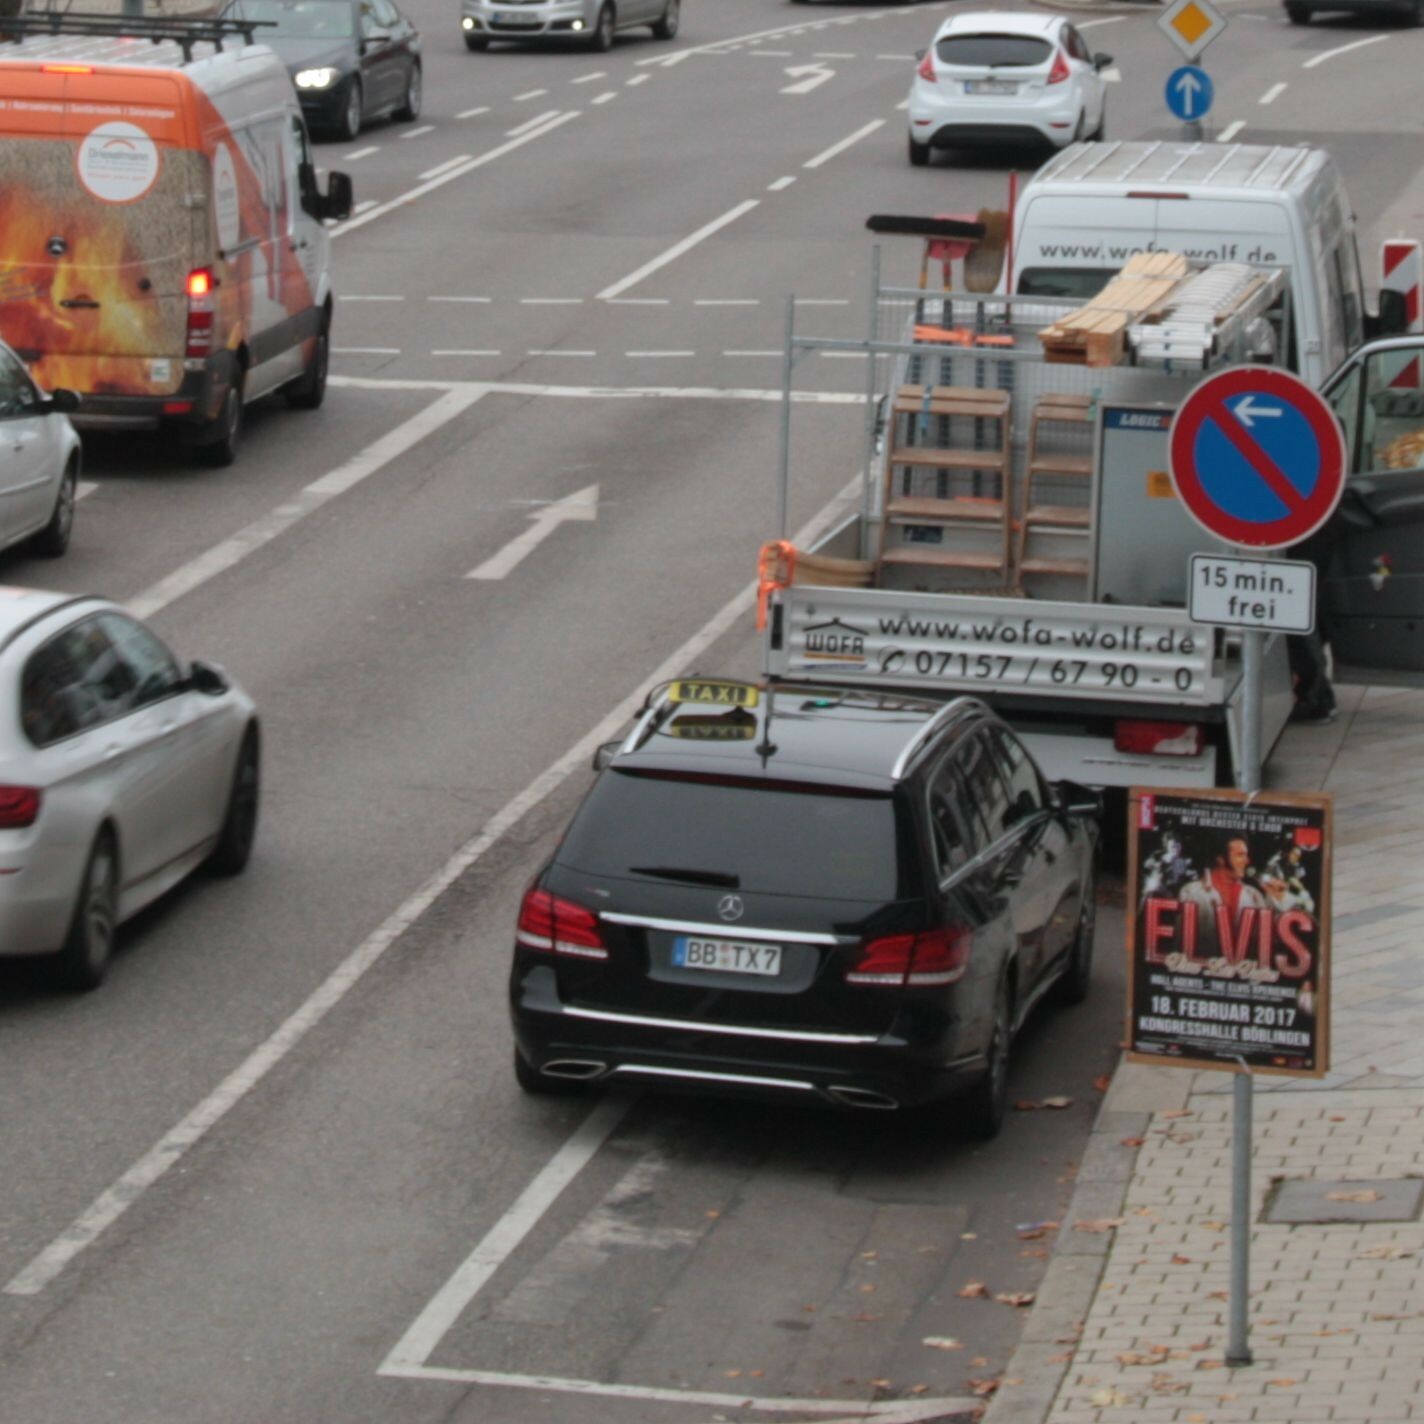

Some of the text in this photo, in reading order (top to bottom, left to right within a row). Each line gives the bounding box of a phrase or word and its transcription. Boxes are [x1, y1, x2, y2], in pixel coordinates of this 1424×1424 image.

[1200, 565, 1294, 595] 15 min.
[1228, 596, 1276, 620] frei
[806, 632, 865, 656] WOFA
[878, 617, 1196, 655] www.wofa-wolf.de
[914, 649, 1011, 678] 07157
[1050, 661, 1088, 684] 67
[1102, 663, 1139, 688] 90
[1175, 667, 1193, 691] 0
[687, 684, 740, 703] TAXI
[1145, 897, 1314, 978] ELVIS
[687, 941, 717, 965] BB
[1151, 995, 1296, 1027] 18. FEBRUAR 2017
[1138, 1016, 1311, 1047] KONGRESSHALLE BÖBLINGEN
